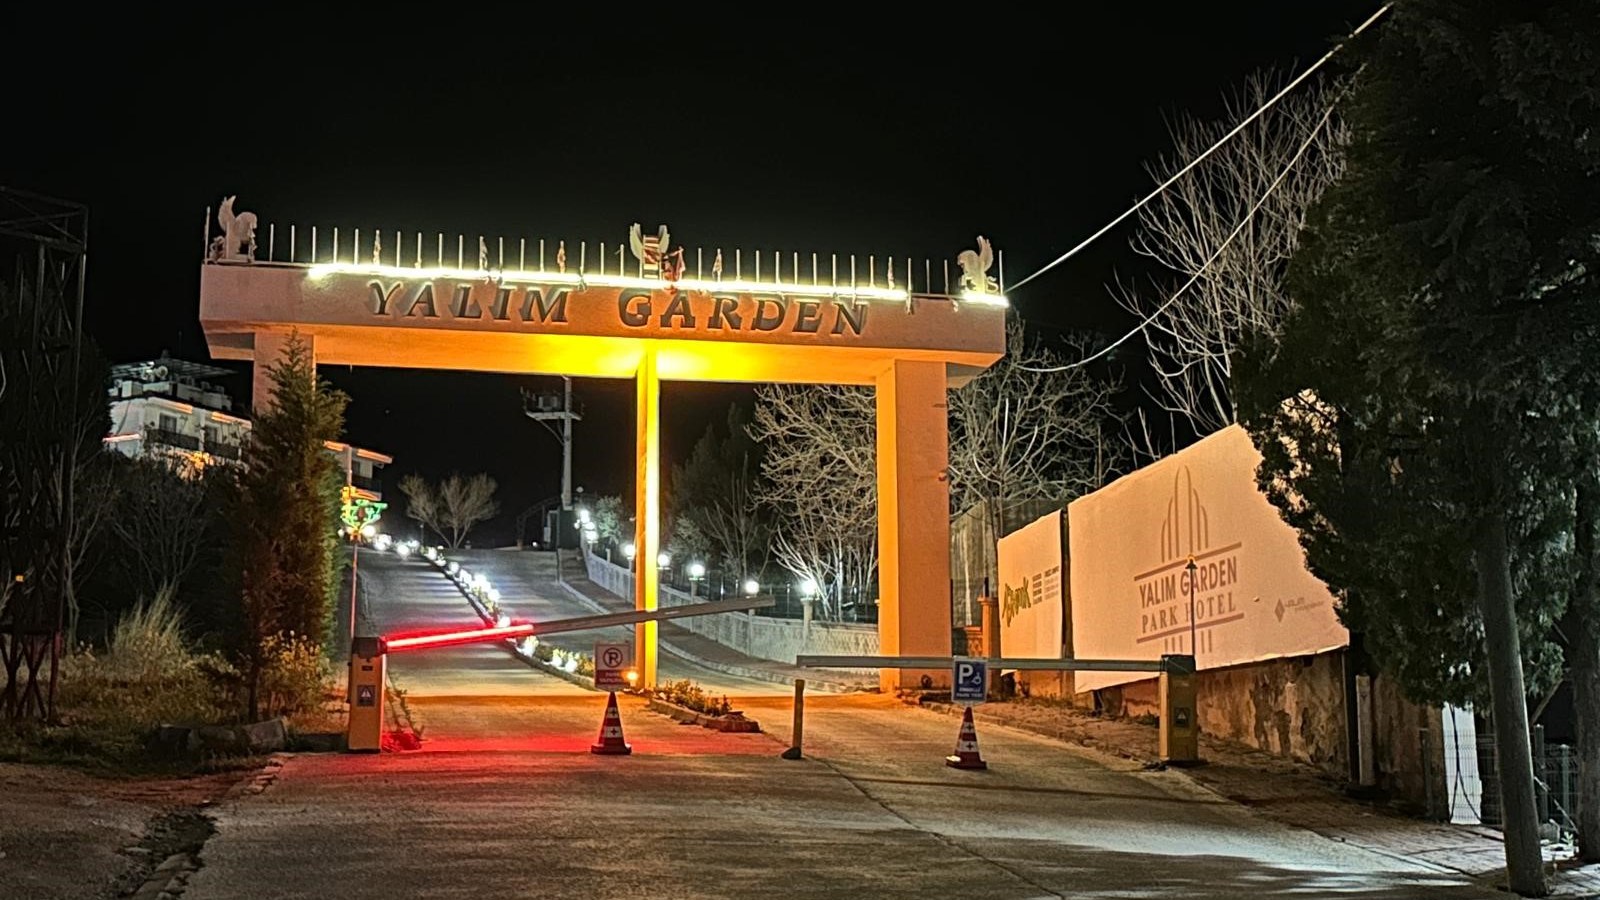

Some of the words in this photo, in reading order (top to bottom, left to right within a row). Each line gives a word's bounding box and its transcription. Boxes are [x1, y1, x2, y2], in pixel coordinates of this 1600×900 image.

[367, 280, 571, 323] YALIM
[617, 287, 869, 335] GARDEN
[1139, 573, 1177, 609] YALIM
[1180, 555, 1238, 597] GARDEN
[1142, 605, 1179, 634] PARK
[958, 663, 974, 685] P
